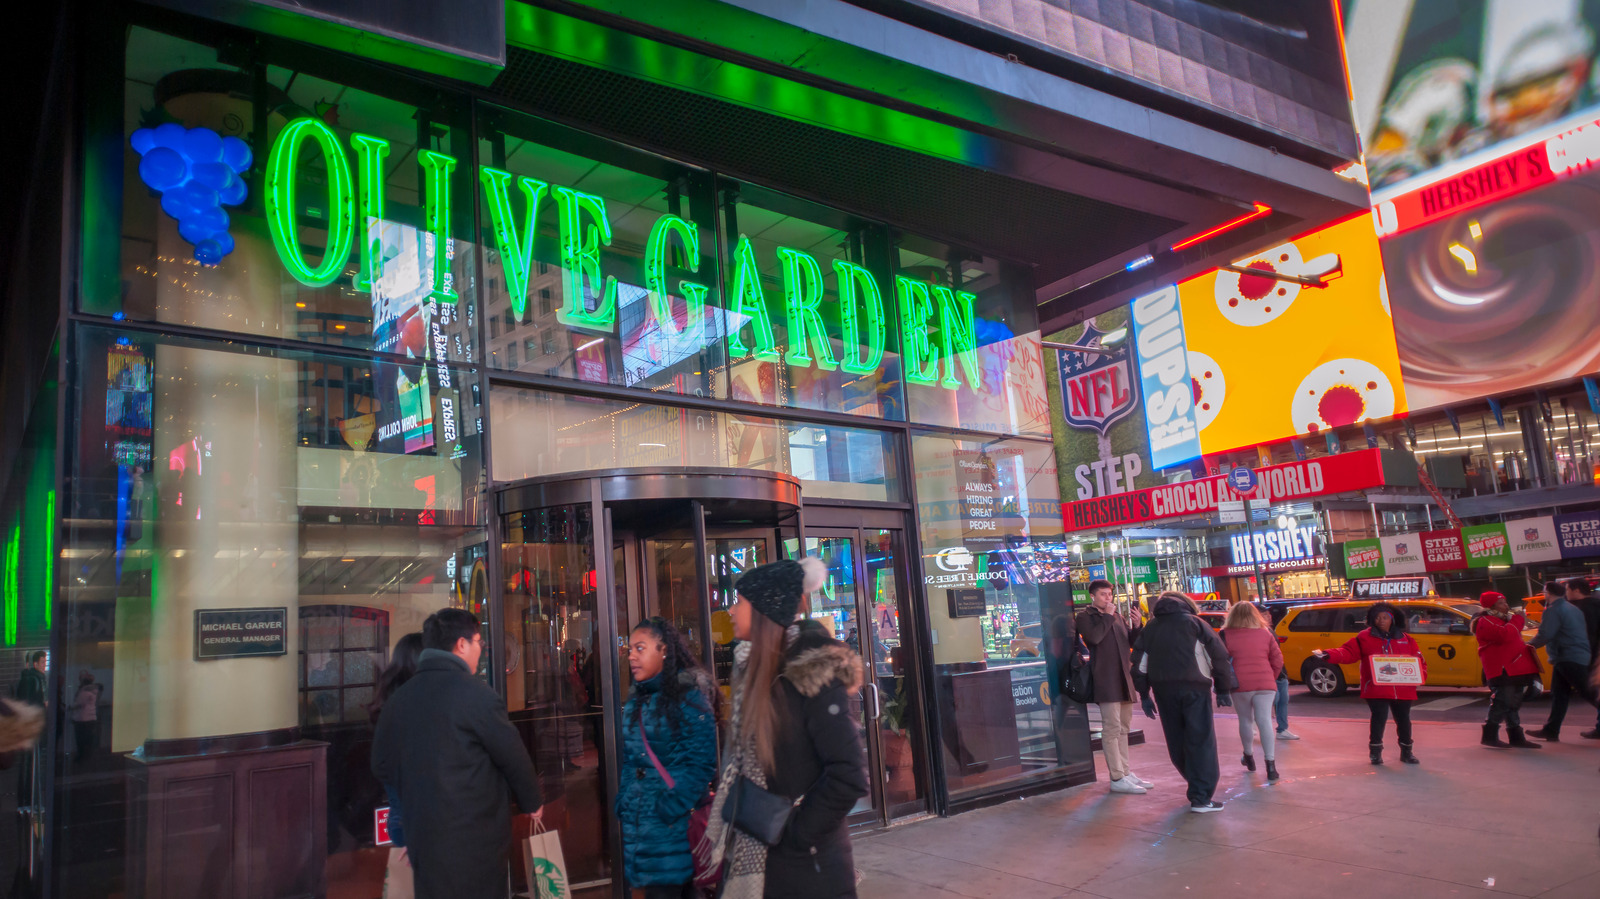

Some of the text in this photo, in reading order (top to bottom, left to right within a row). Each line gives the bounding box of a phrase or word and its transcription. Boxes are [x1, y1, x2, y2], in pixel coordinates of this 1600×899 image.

[1420, 149, 1543, 218] HERSHEY'S
[265, 117, 617, 332] OLIVE
[644, 213, 981, 394] GARDEN
[1067, 365, 1128, 418] NFL
[1074, 452, 1142, 500] STEP
[965, 482, 993, 493] ALWAYS
[966, 495, 994, 505] HIRING
[1073, 492, 1150, 528] HERSHEY'S
[1256, 462, 1324, 500] WORLD
[970, 508, 993, 518] GREAT
[969, 520, 996, 530] PEOPLE
[1560, 520, 1600, 532] STEP
[1584, 529, 1600, 537] THE
[1425, 537, 1458, 548] STEP
[1468, 542, 1485, 553] NOW
[1563, 536, 1600, 548] GAME
[1428, 552, 1462, 562] GAME
[1228, 563, 1266, 573] HERSHE'S
[1269, 558, 1315, 569] CHOCOLATE
[1369, 581, 1419, 595] BLOCKERS
[202, 621, 282, 631] MICHAEL GARVER
[242, 634, 280, 642] MANAGER
[1012, 684, 1033, 697] tation
[1015, 697, 1038, 706] Brooklyn
